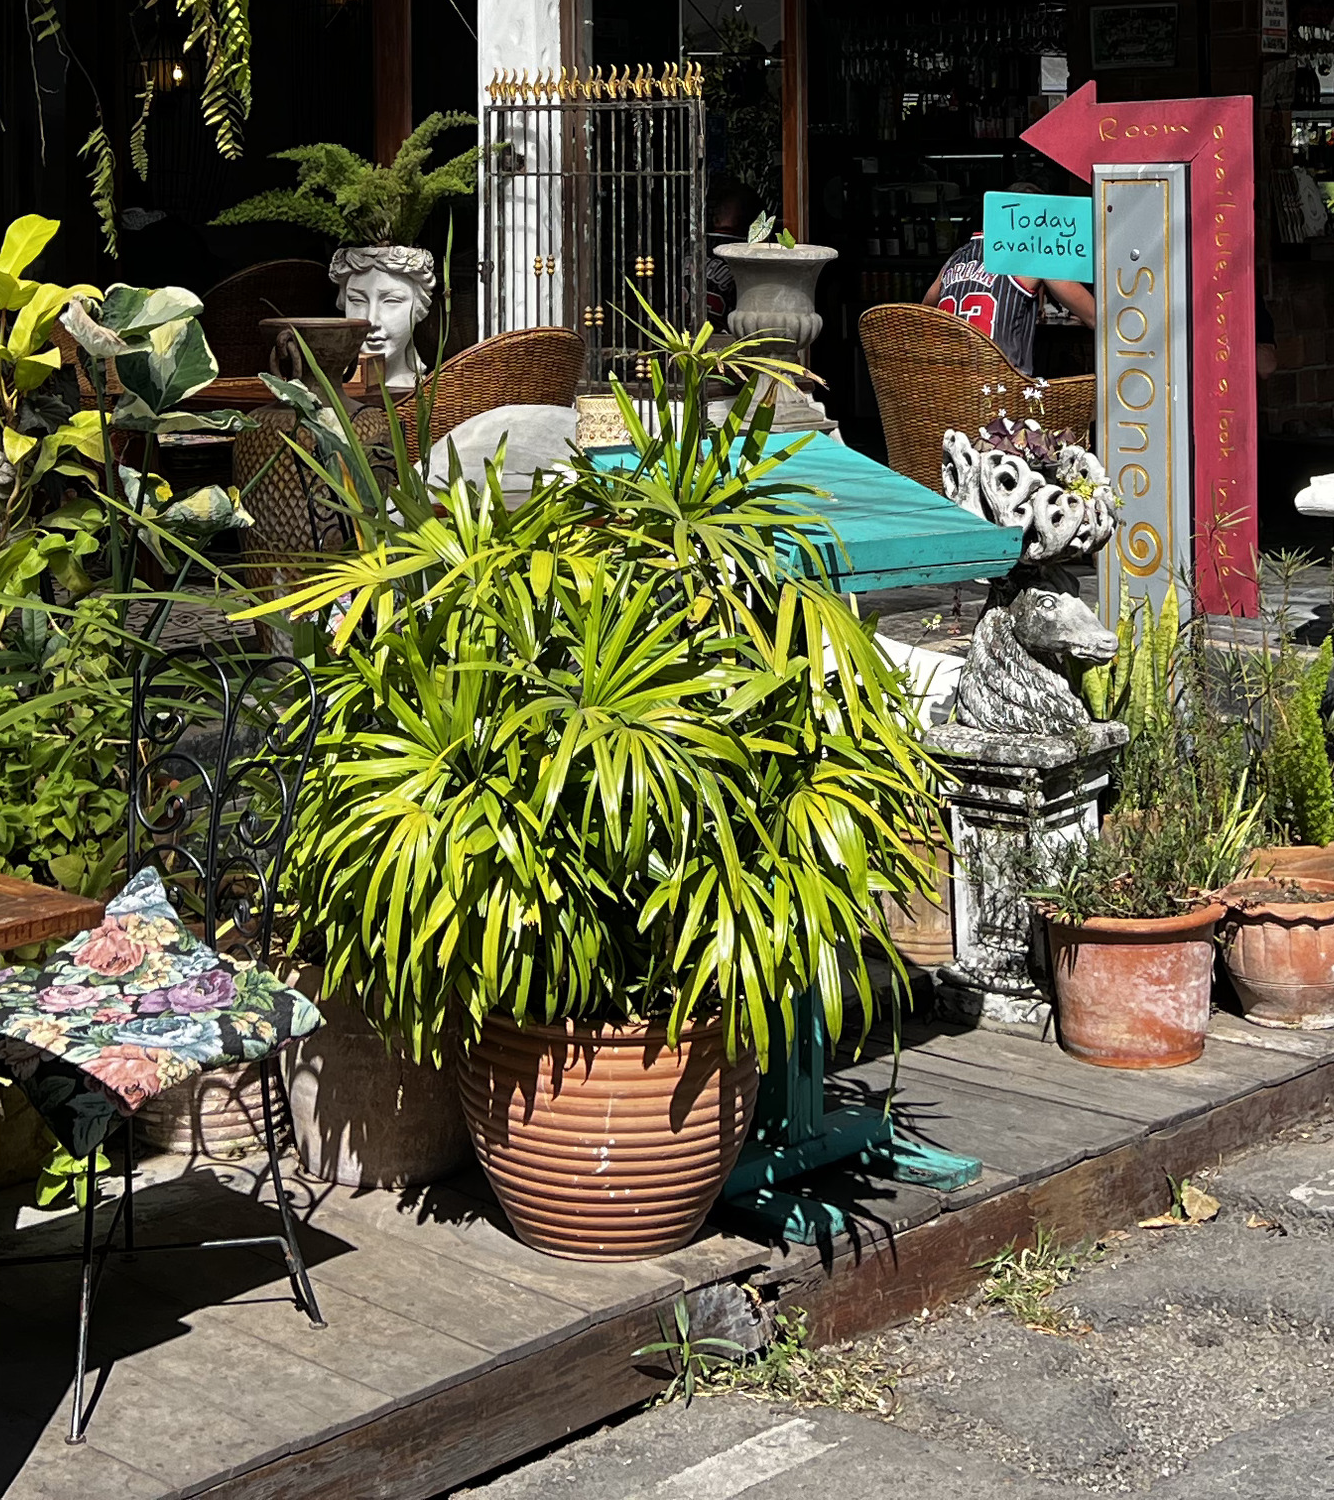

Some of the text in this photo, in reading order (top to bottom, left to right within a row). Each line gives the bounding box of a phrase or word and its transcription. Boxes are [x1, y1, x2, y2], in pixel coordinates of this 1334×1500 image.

[1099, 117, 1190, 141] Room
[1001, 202, 1076, 238] Today
[992, 235, 1087, 258] available
